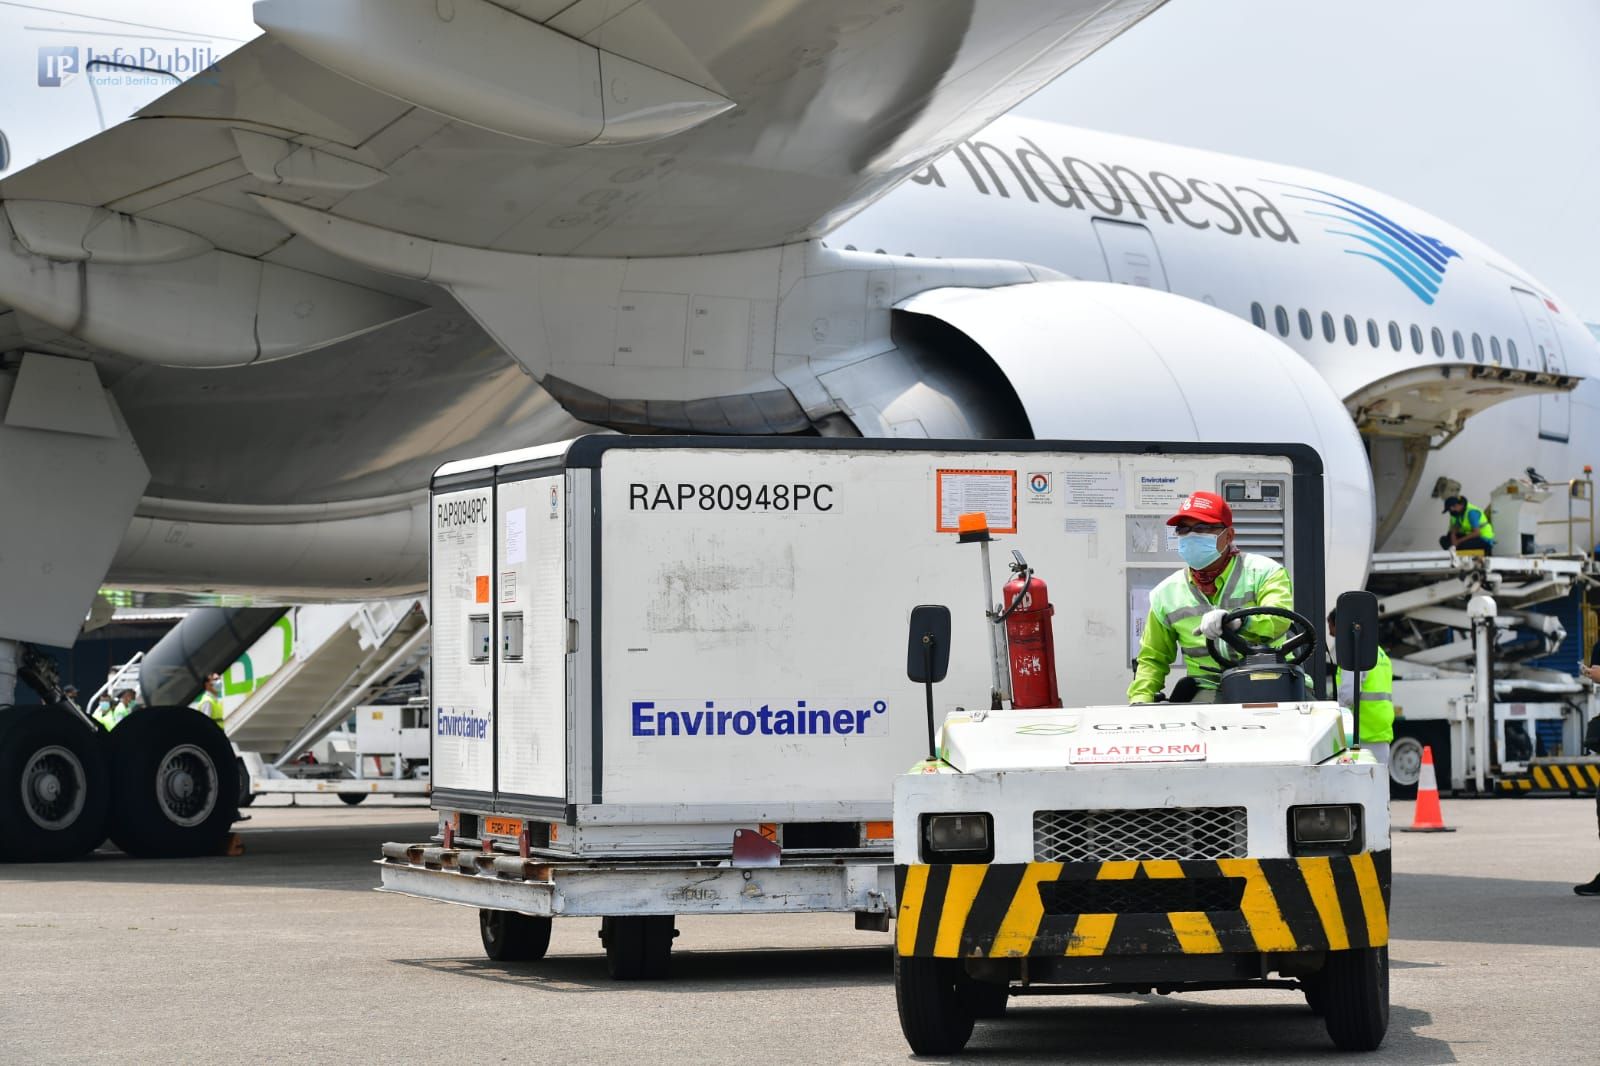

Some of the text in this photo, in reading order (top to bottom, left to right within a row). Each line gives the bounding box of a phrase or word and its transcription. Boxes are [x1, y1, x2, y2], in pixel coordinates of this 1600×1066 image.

[629, 483, 833, 512] RAP80948PC
[437, 497, 488, 528] RAP80948PC
[1076, 744, 1201, 756] PLATFORM
